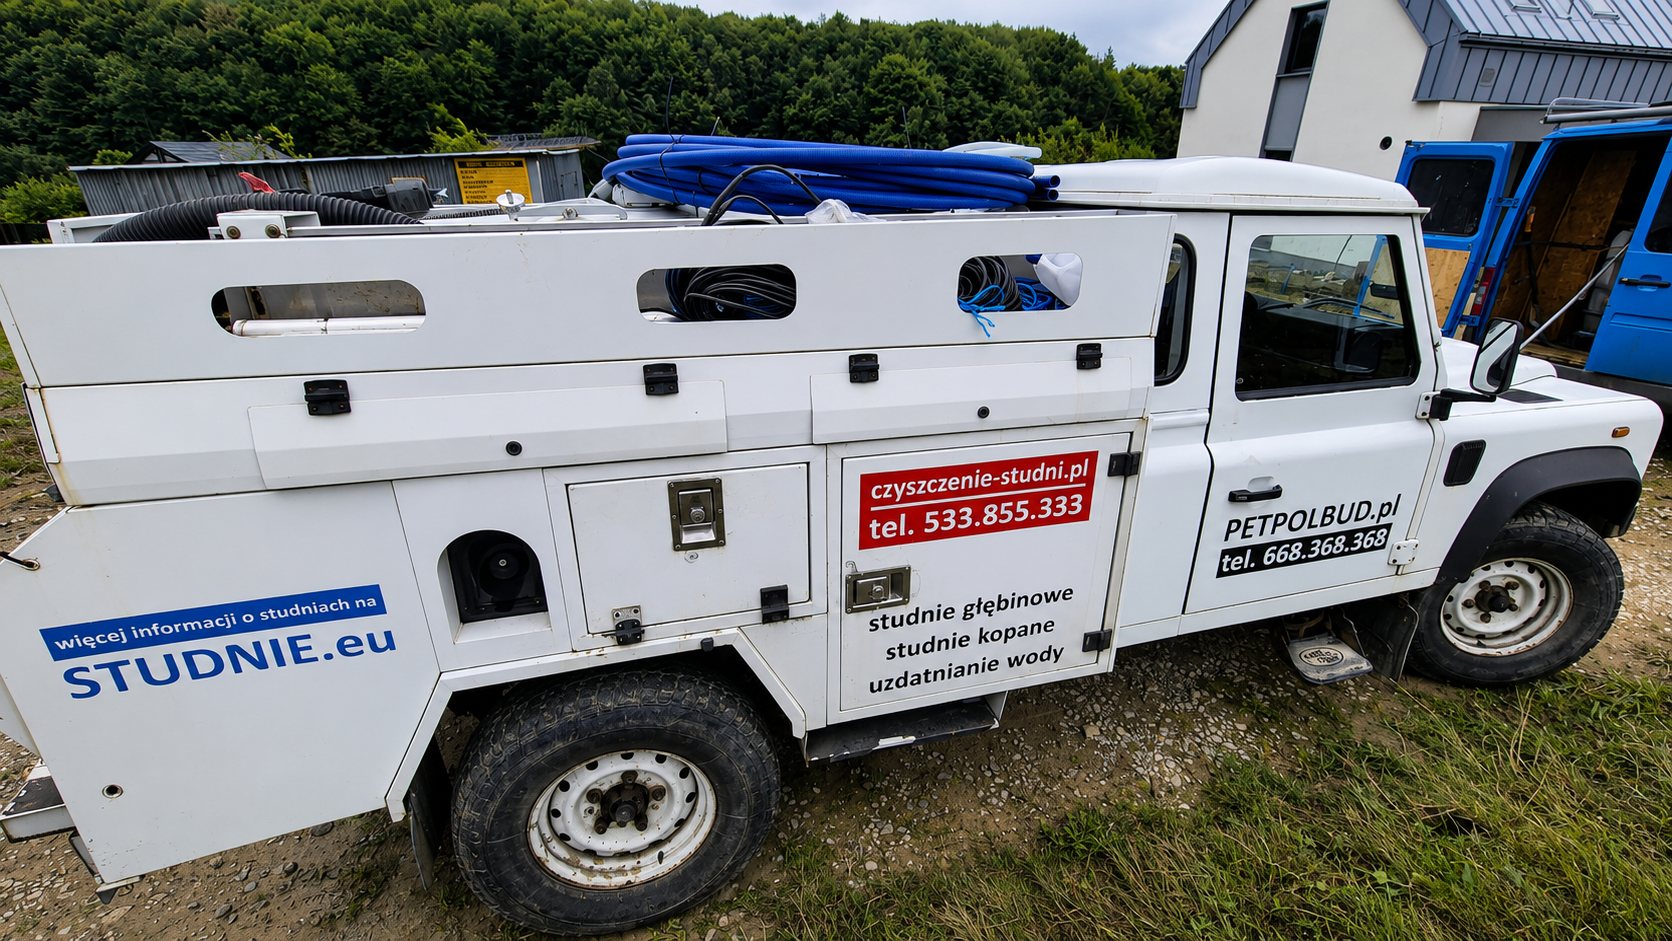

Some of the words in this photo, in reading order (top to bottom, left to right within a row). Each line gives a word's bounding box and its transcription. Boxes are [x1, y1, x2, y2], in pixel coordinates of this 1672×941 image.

[871, 458, 1090, 501] czyszczenie-studni.pl
[869, 513, 914, 540] tel.
[924, 493, 1084, 533] 533.855.333
[1223, 493, 1402, 542] PETPOLBUD.pl
[1221, 549, 1255, 573] tel.
[1262, 528, 1388, 566] 668.368.368
[54, 629, 127, 650] więcej
[132, 612, 238, 640] informacji
[241, 610, 254, 623] o
[259, 597, 350, 621] studniach
[354, 595, 377, 608] na
[868, 604, 956, 632] studnie
[961, 587, 1074, 621] głębinowe
[62, 629, 397, 699] STUDNIE.eu
[885, 631, 971, 661] studnie
[978, 620, 1056, 645] kopane
[869, 656, 1000, 694] uzdatnianie
[1007, 645, 1065, 668] wody
